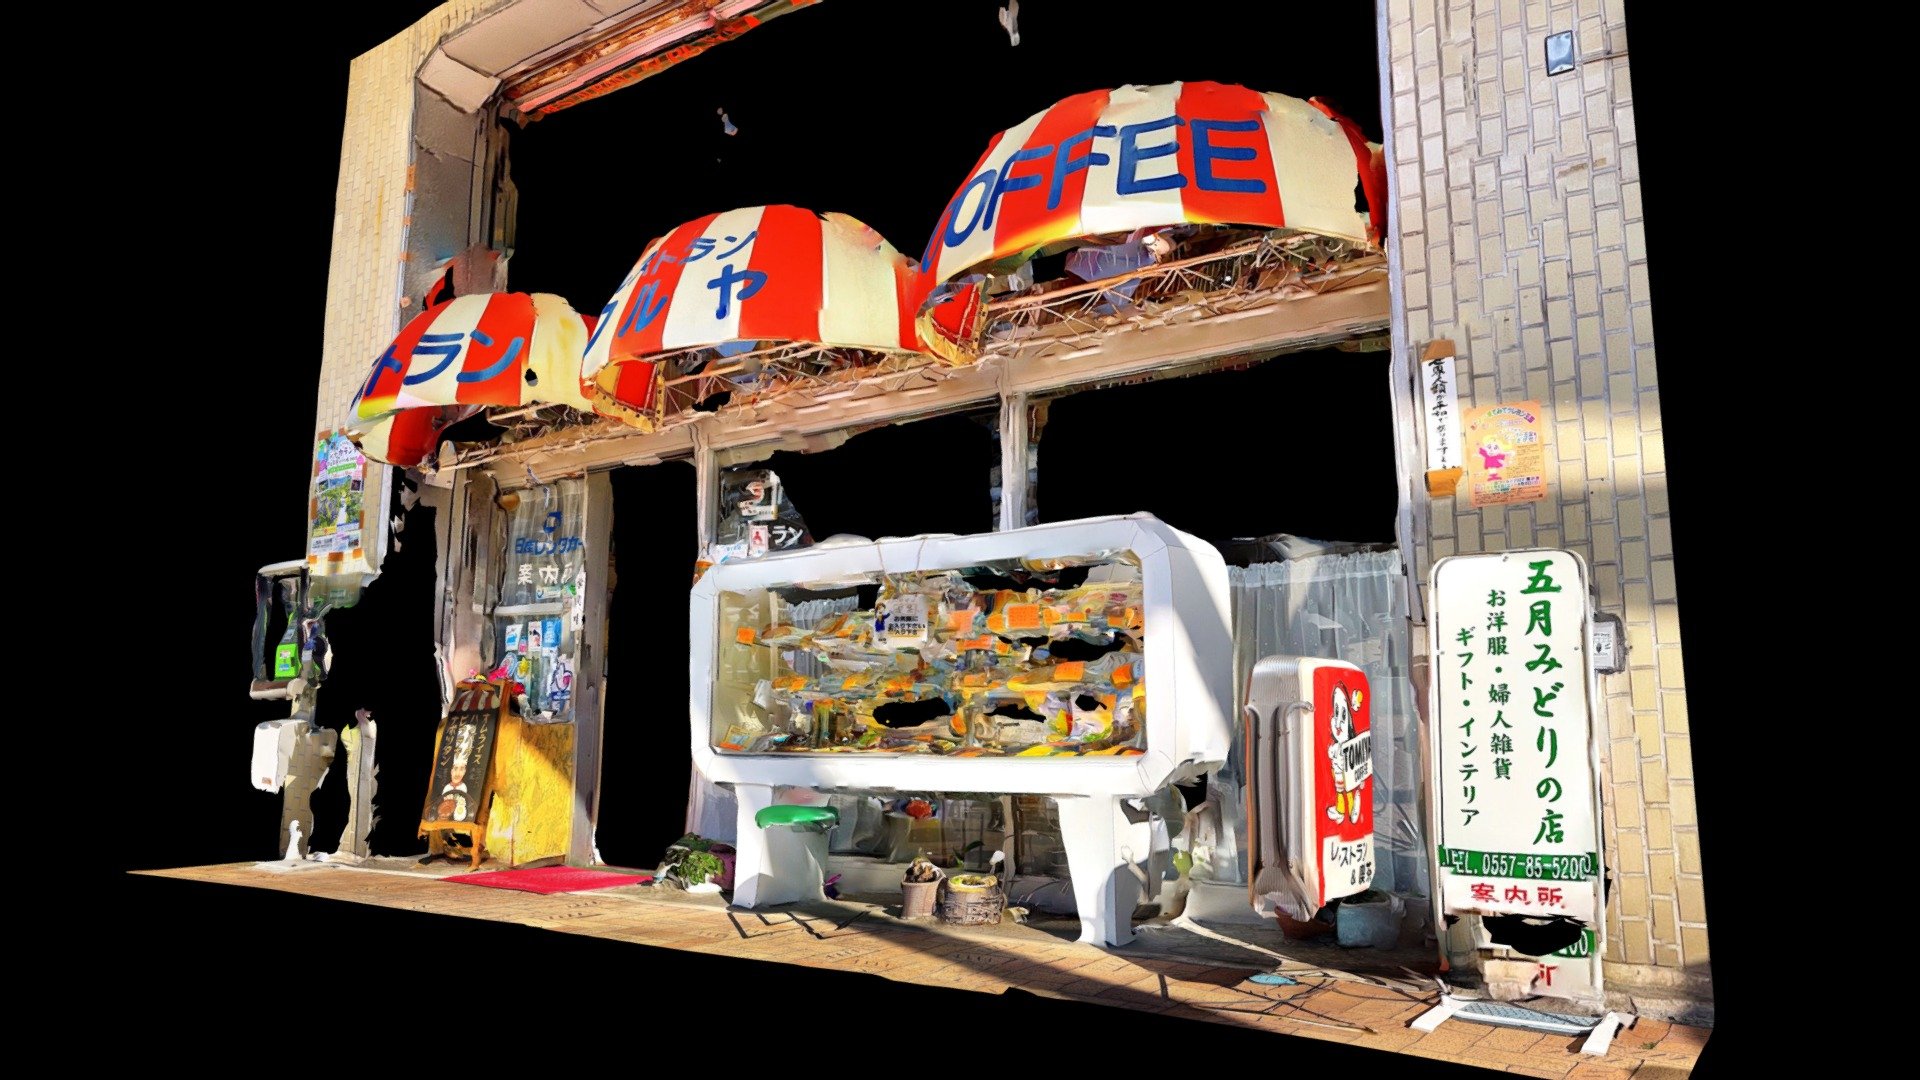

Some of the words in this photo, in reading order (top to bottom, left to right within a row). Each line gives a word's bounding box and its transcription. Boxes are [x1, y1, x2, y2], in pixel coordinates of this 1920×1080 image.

[615, 231, 758, 293] トラン
[921, 115, 1267, 273] COFFEE
[351, 329, 525, 407] トラン
[1455, 626, 1480, 827] ギフト・インテリア
[1486, 589, 1514, 781] お洋服・婦人雑貨
[1520, 559, 1564, 846] 五月みどりの店
[1470, 882, 1566, 909] 案内所
